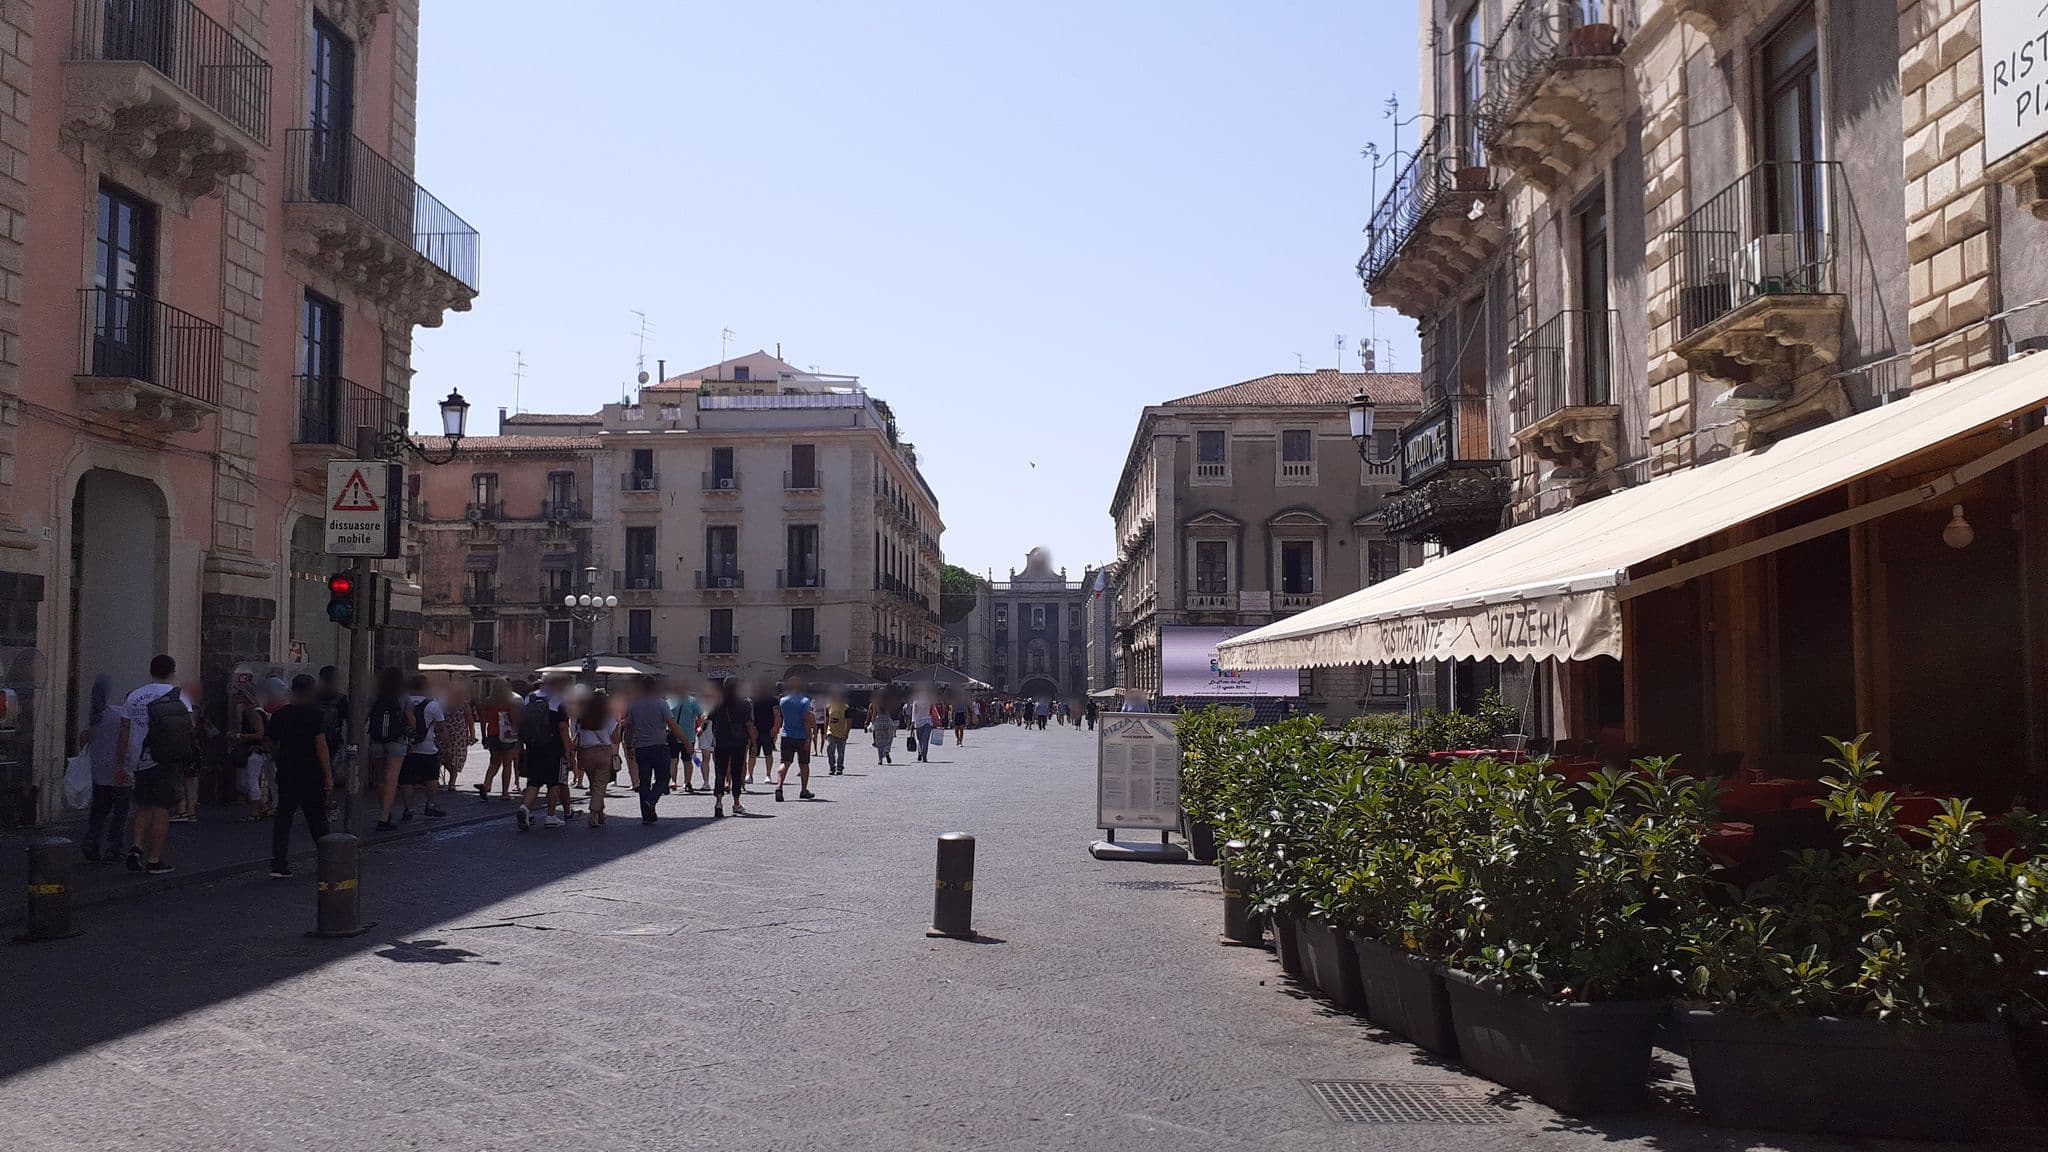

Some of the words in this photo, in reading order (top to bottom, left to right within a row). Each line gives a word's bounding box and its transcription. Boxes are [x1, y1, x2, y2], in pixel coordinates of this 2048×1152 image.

[2016, 79, 2048, 127] PI
[329, 520, 381, 531] dissuasore
[337, 533, 371, 544] mobile
[1381, 619, 1446, 655] RISTORANTE
[1490, 606, 1571, 648] PIZZERIA
[1103, 717, 1132, 737] PIZZA
